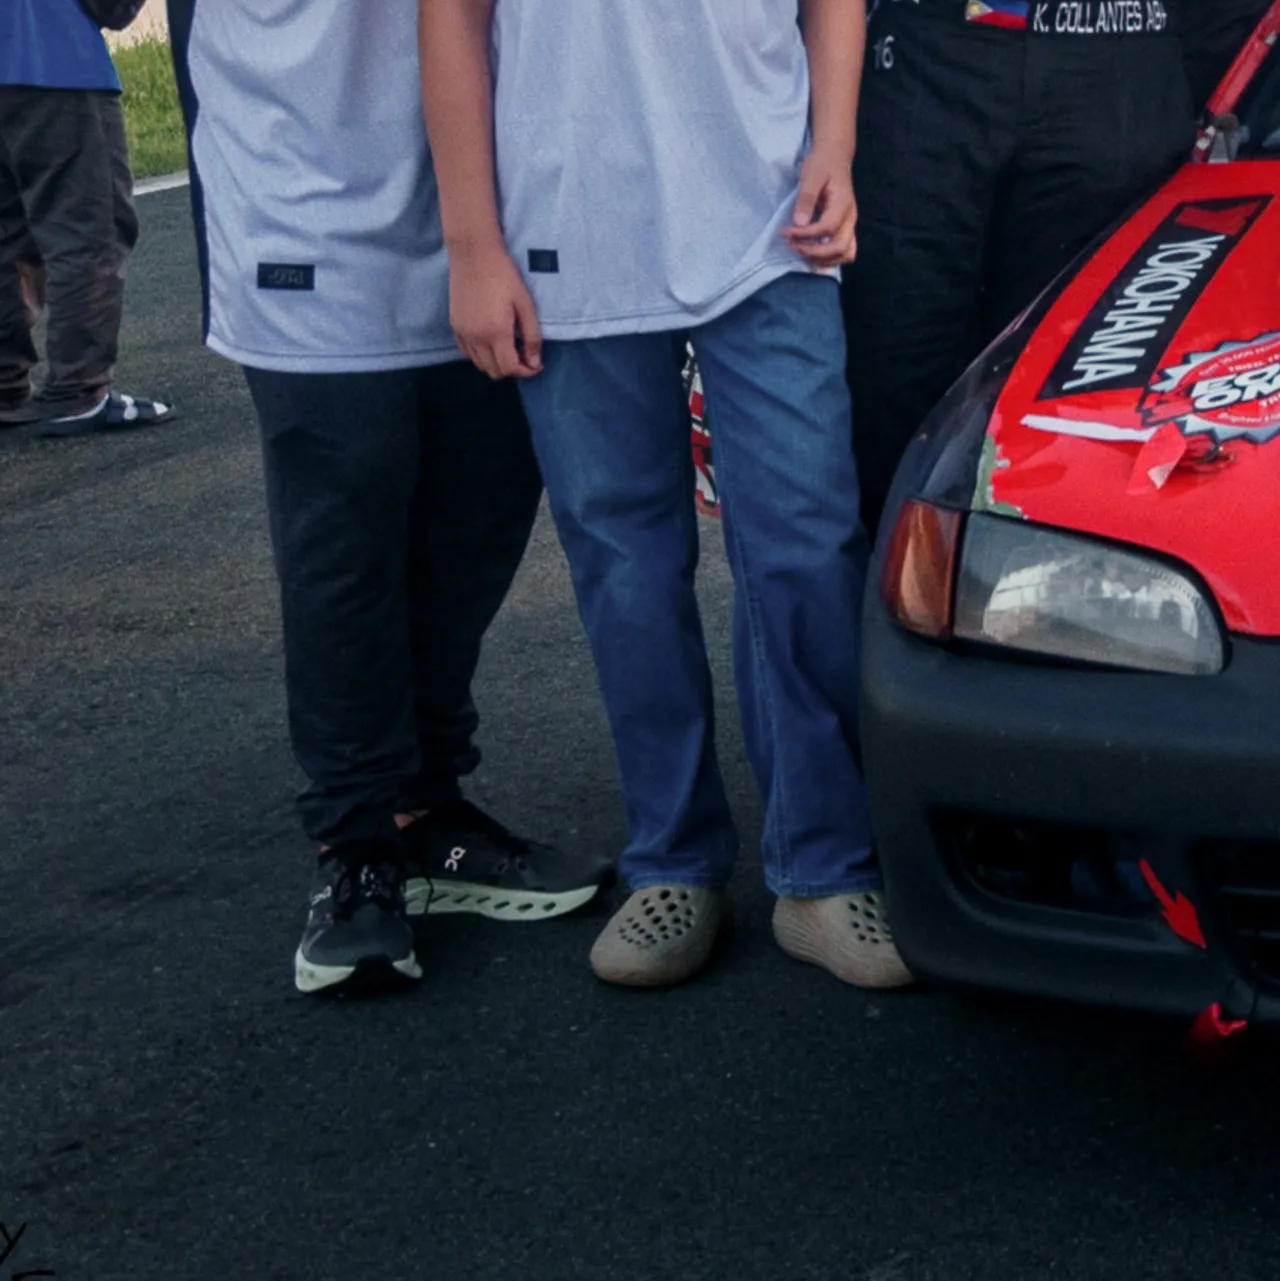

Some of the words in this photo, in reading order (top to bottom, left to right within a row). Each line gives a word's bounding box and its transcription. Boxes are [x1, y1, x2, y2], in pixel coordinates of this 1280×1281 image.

[1033, 2, 1050, 33] K.
[1055, 2, 1143, 34] COLLANTES
[1061, 234, 1228, 391] YOKOHAMA
